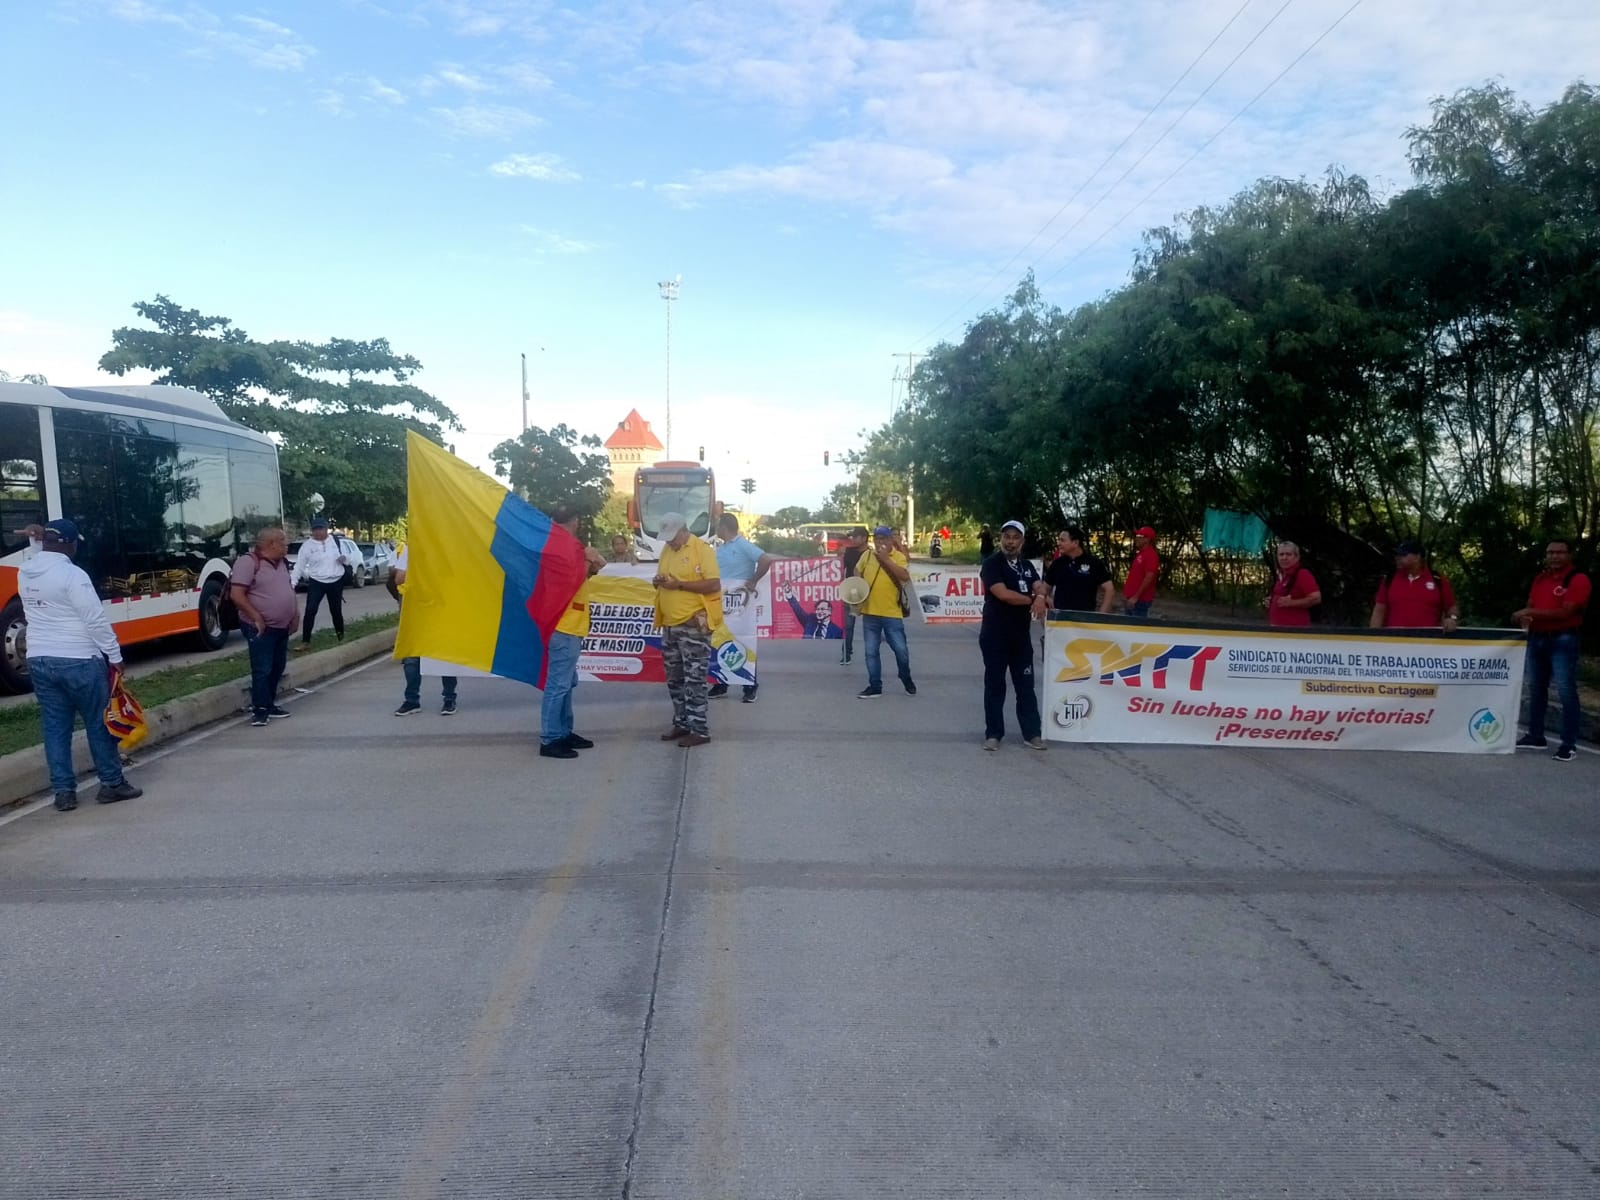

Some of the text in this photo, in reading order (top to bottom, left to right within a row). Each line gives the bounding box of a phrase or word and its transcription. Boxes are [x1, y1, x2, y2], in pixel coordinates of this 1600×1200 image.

[775, 559, 842, 583] FIRMES
[775, 585, 842, 602] CN PETRO
[603, 605, 619, 617] DE
[619, 606, 640, 618] LOS
[944, 608, 976, 616] Unidos
[589, 621, 642, 635] SUARIOS
[600, 639, 644, 652] MASIVO
[1056, 638, 1223, 691] SNTT
[1228, 649, 1510, 671] SINDICATO NACIONAL DE TRABAJADORES DE RAMA,
[1228, 663, 1269, 673] SERVICIOS
[1271, 664, 1281, 674] DE
[1283, 665, 1293, 674] LA
[1295, 665, 1336, 676] INDUSTRIA
[1338, 667, 1352, 676] DEL
[1355, 668, 1408, 678] TRANSPORTE
[1461, 671, 1470, 680] DE
[1472, 671, 1509, 680] COLOMBIA
[1306, 682, 1434, 698] Subdirectiva Cartagena
[1127, 697, 1434, 725] Sin luchas no hay victorias!
[1215, 723, 1345, 742] ¡Presentes!
